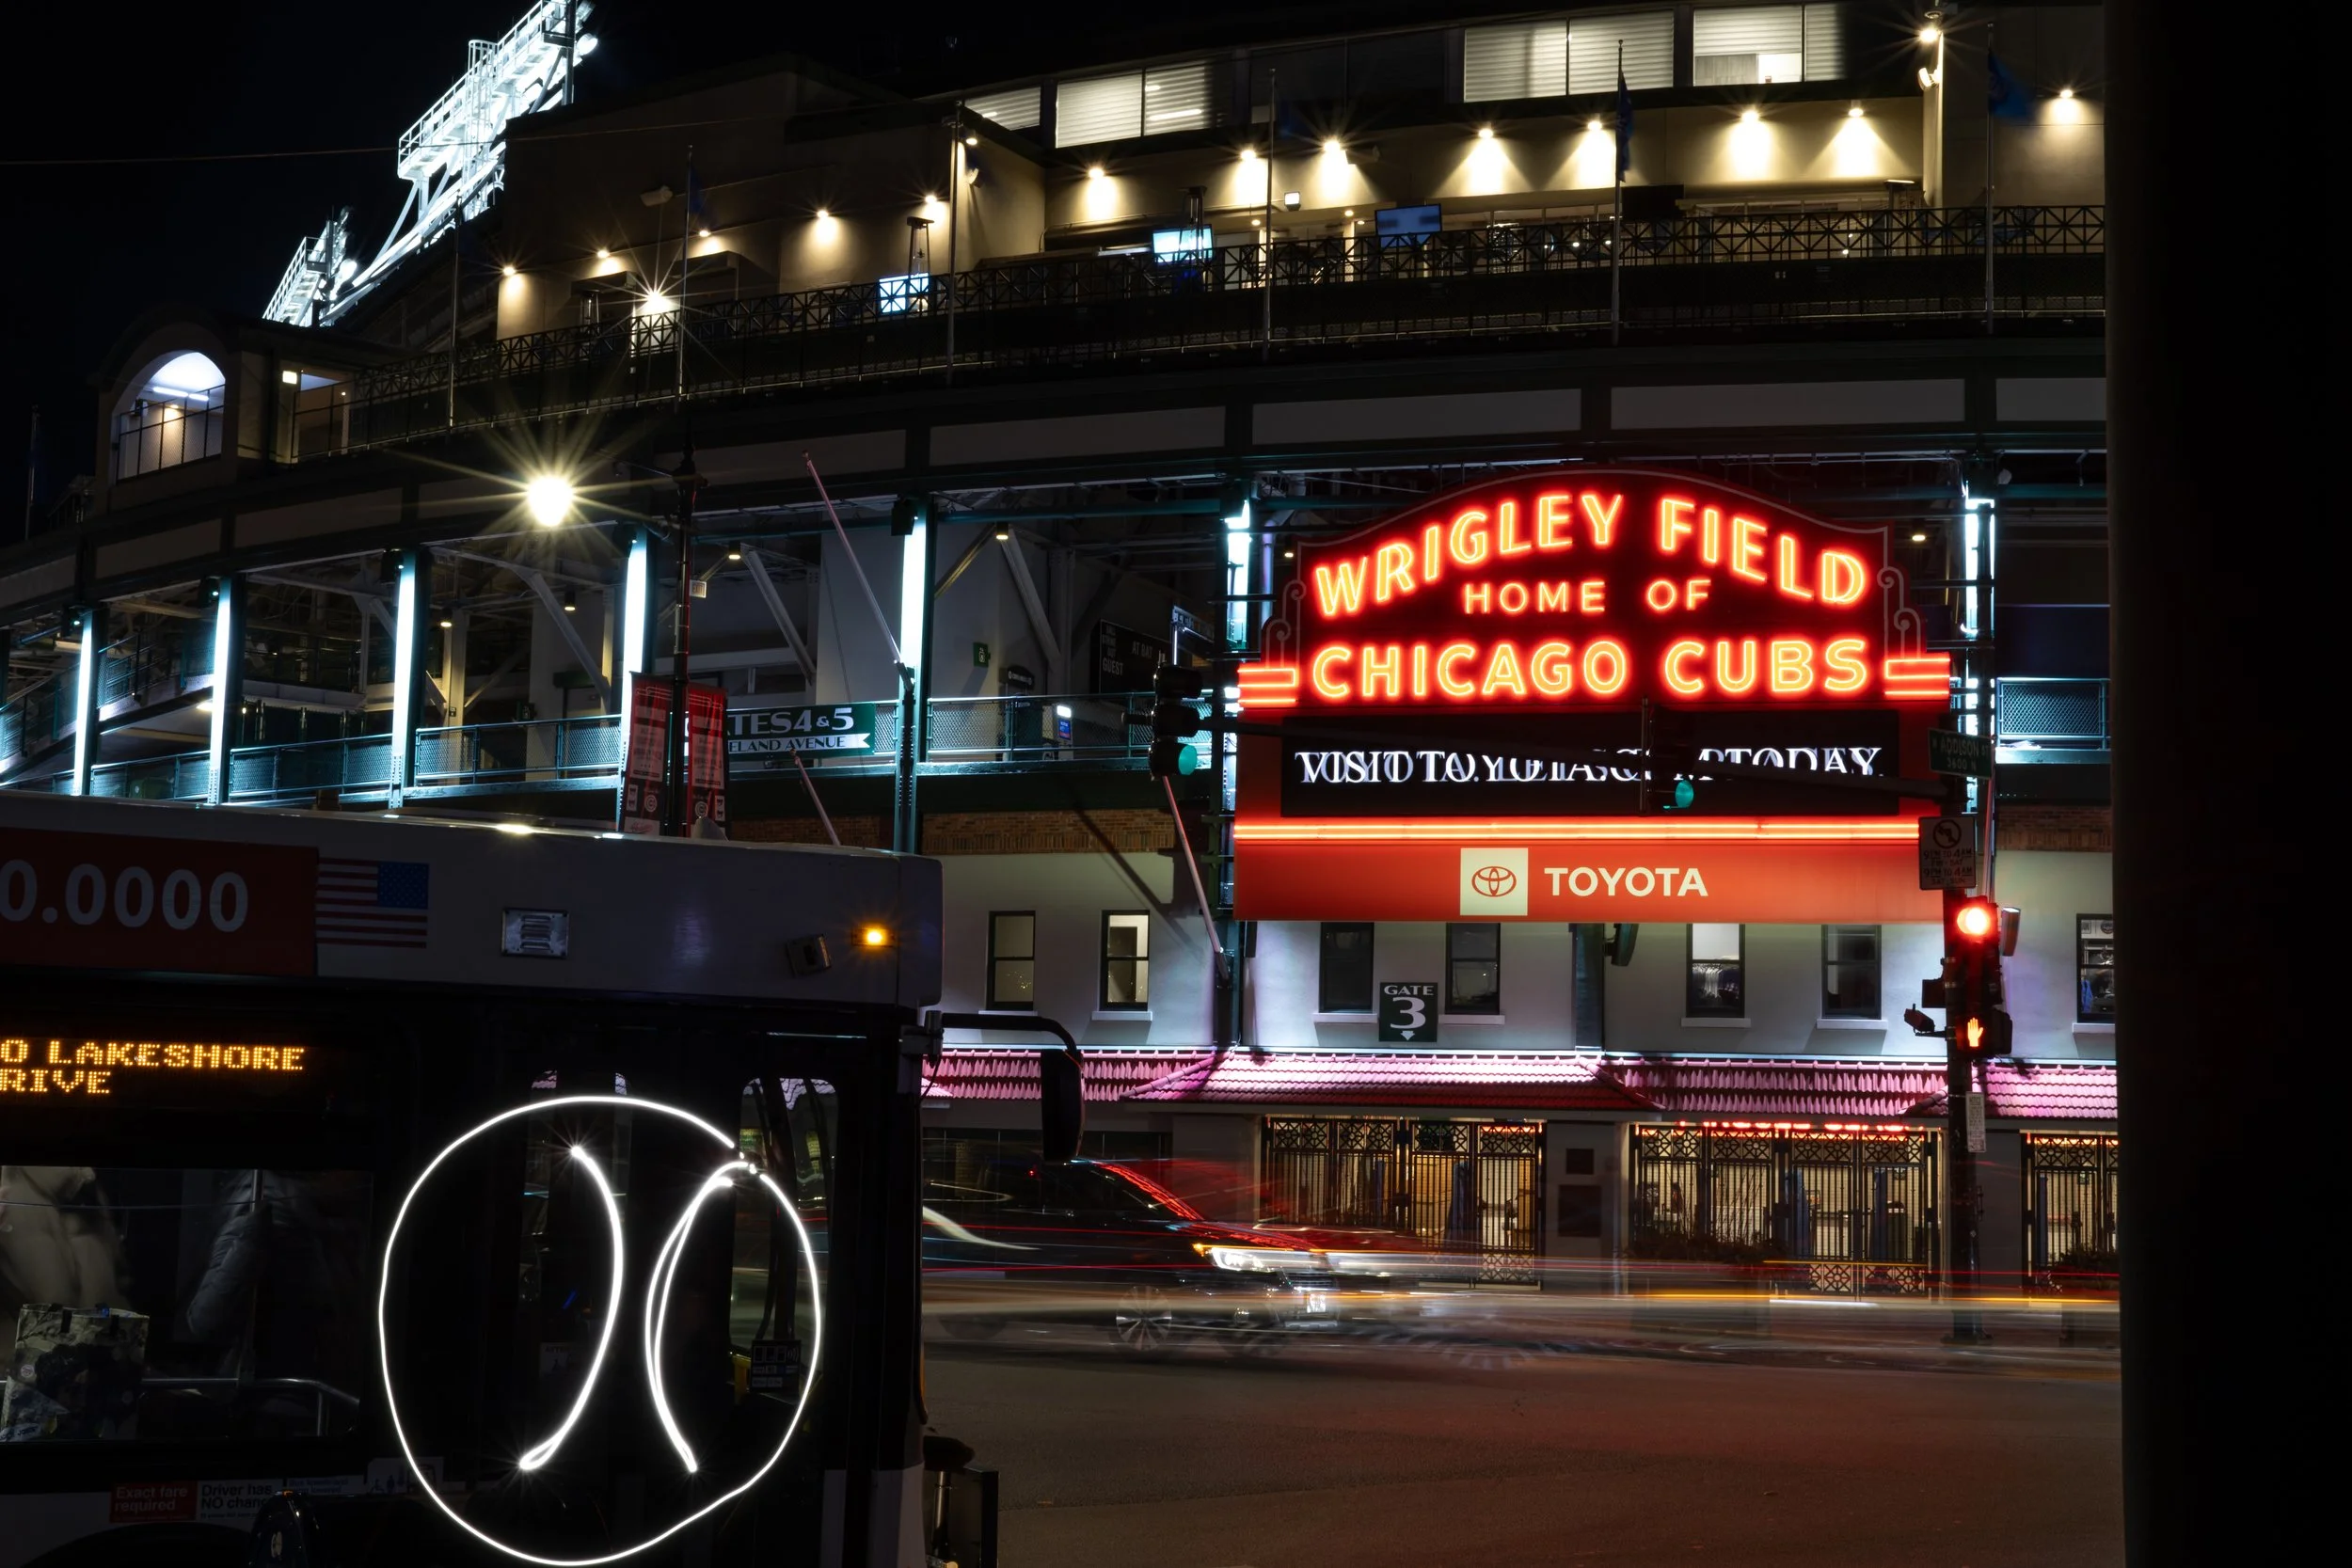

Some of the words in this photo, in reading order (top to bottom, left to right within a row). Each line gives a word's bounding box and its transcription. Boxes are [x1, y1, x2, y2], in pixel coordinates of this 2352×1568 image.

[1314, 494, 1623, 616] WRIGLEY
[1661, 497, 1867, 606] FIELD
[1462, 580, 1606, 615] HOME
[1646, 578, 1712, 611] OF
[1102, 657, 1124, 676] GUEST
[1311, 641, 1628, 699] CHICAGO
[1663, 638, 1868, 695] CUBS
[727, 711, 792, 736] TES
[729, 739, 782, 752] ELAND
[784, 736, 846, 751] AVENUE
[1940, 736, 1979, 758] ADDISON
[1544, 866, 1708, 897] TOYOTA
[0, 859, 248, 932] 0.0000
[1384, 985, 1435, 996] GATE
[1390, 996, 1426, 1030] 3
[49, 1040, 305, 1070] LAKESHORE
[0, 1069, 111, 1094] RIVE
[116, 1485, 158, 1499] Exact
[160, 1484, 188, 1498] fare
[201, 1483, 245, 1497] Driver
[246, 1482, 273, 1496] has
[114, 1497, 176, 1514] required
[200, 1497, 223, 1510] NO
[227, 1497, 269, 1510] chan
